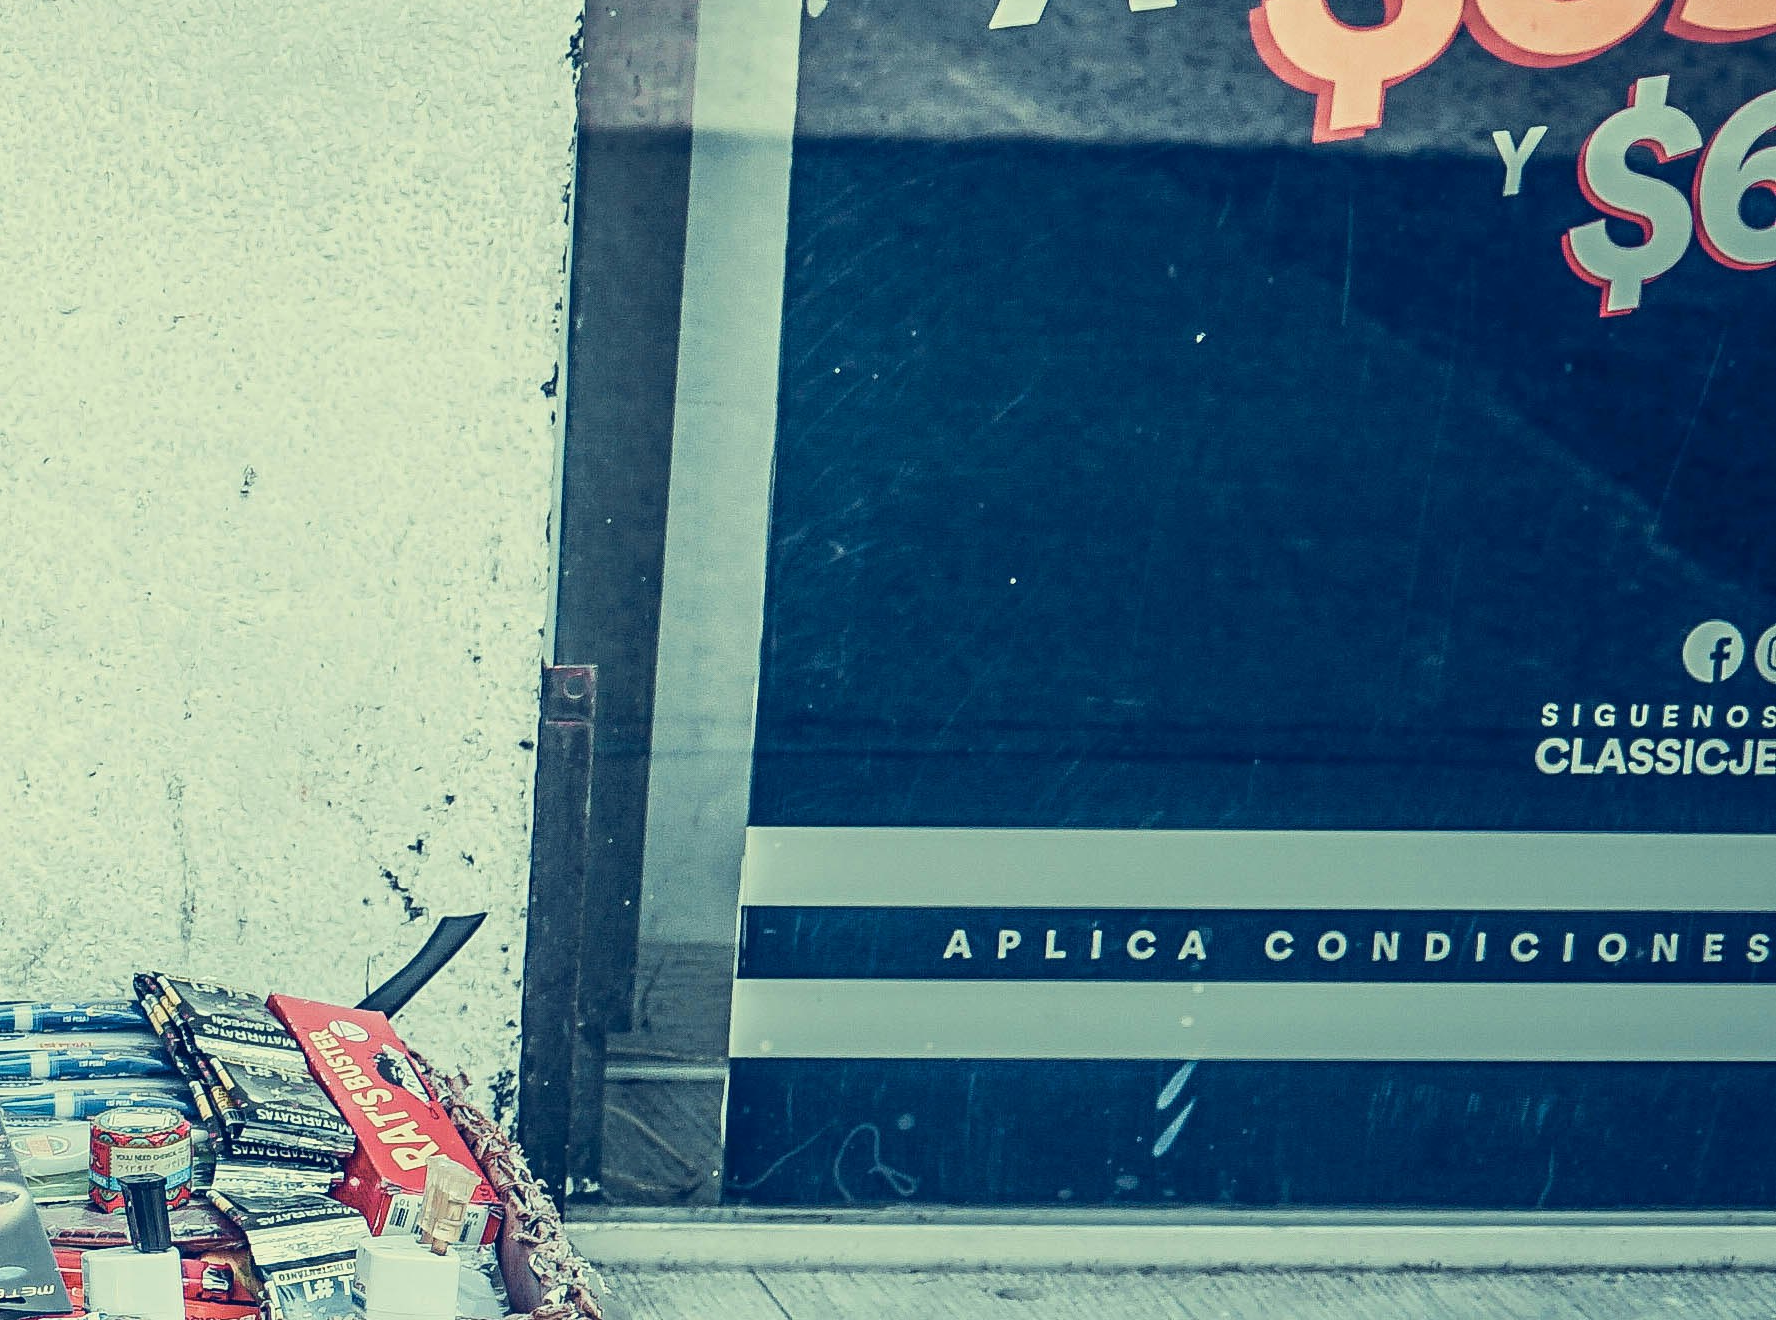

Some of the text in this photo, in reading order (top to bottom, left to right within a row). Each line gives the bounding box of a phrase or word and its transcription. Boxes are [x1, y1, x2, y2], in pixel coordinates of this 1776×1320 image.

[1493, 74, 1776, 318] Y $6
[1541, 702, 1776, 728] SIGUENOS
[1535, 737, 1776, 775] CLASSICJE
[943, 929, 1770, 964] APLICA CONDICIONES
[202, 1023, 297, 1049] MATARRATAS
[308, 1027, 440, 1172] RAT'S BUSTER
[256, 1108, 353, 1135] MATARRATAS
